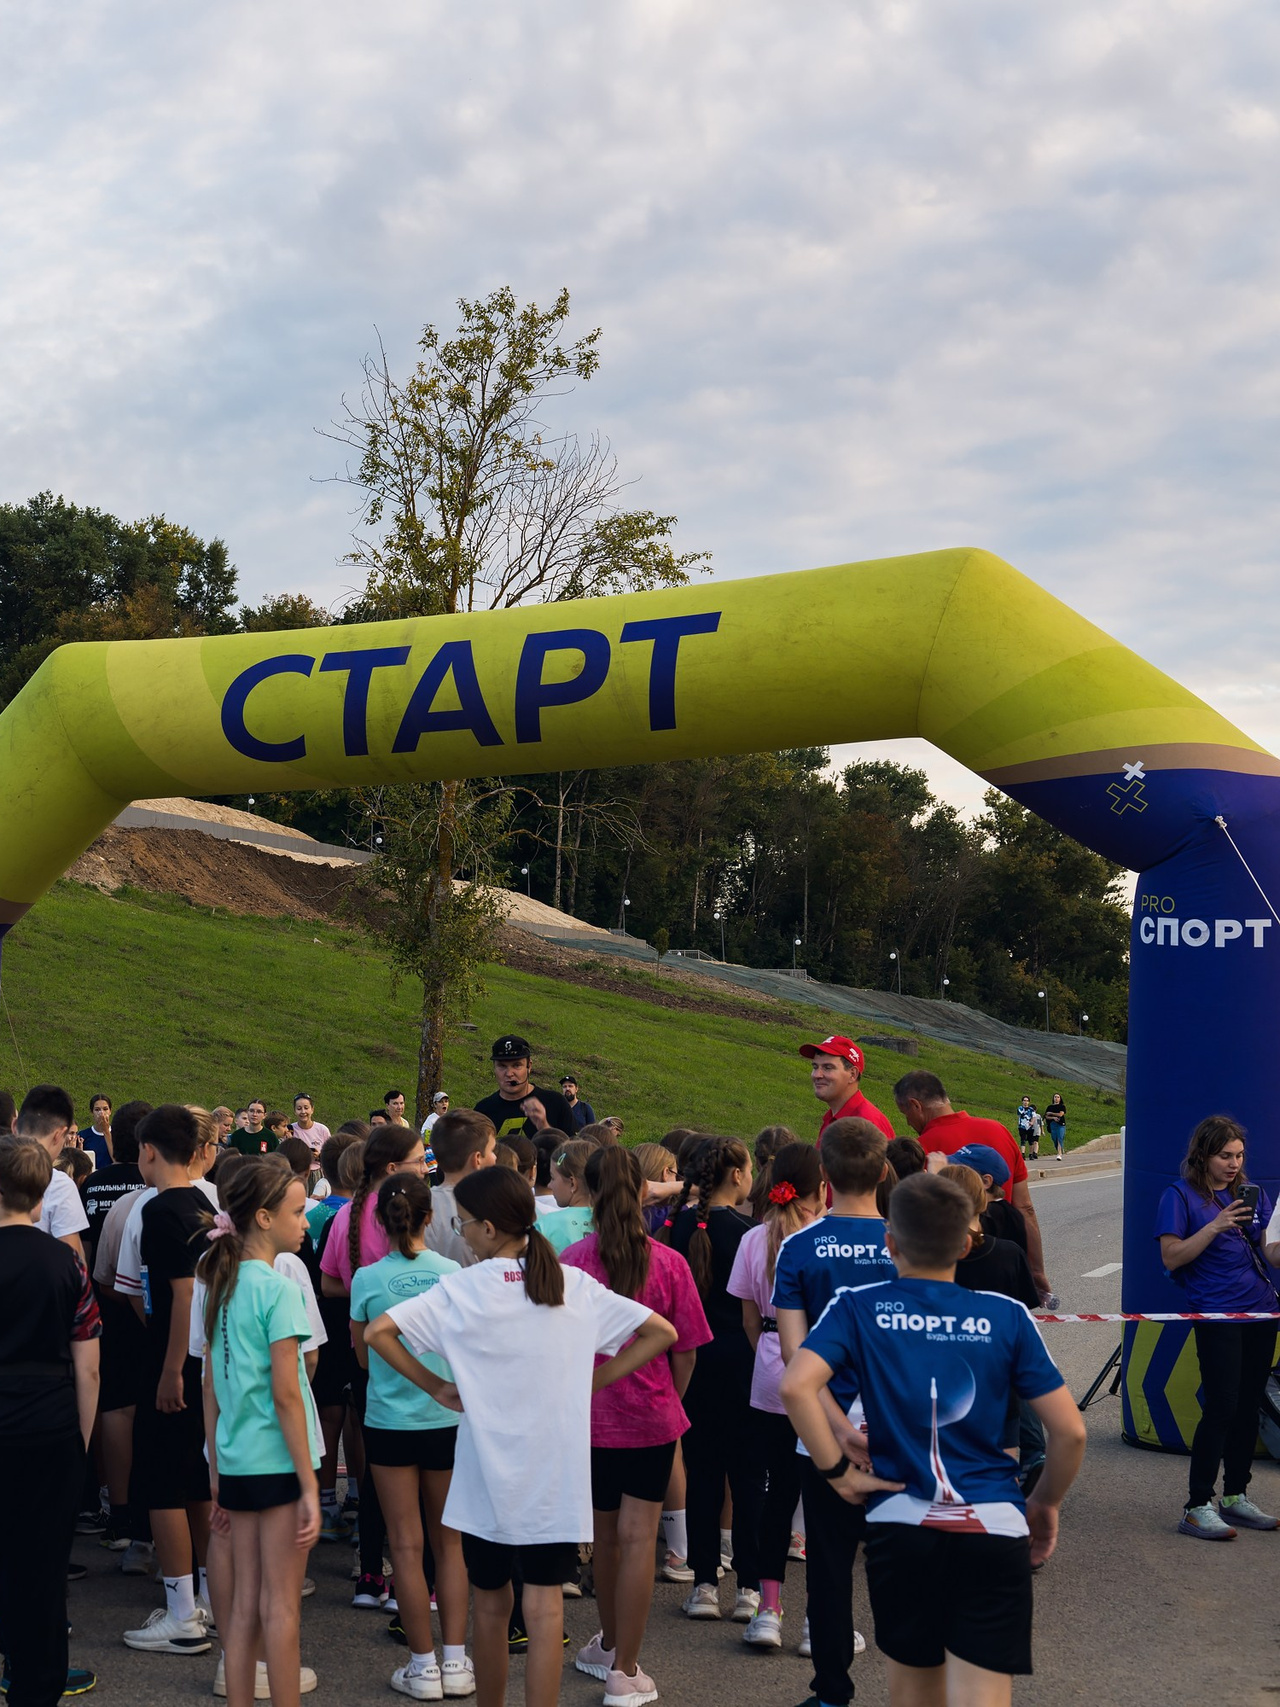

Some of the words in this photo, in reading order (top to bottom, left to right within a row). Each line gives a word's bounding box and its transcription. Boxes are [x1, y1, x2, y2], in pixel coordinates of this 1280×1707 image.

[221, 611, 722, 763] СТАРТ
[1140, 894, 1176, 914] PRO
[1139, 916, 1272, 948] СПОРТ
[814, 1235, 837, 1246] PRO
[815, 1244, 878, 1258] СПОРТ
[880, 1246, 892, 1259] 4
[875, 1301, 905, 1312] PRO
[876, 1313, 957, 1333] СПОРТ
[961, 1316, 992, 1335] 40
